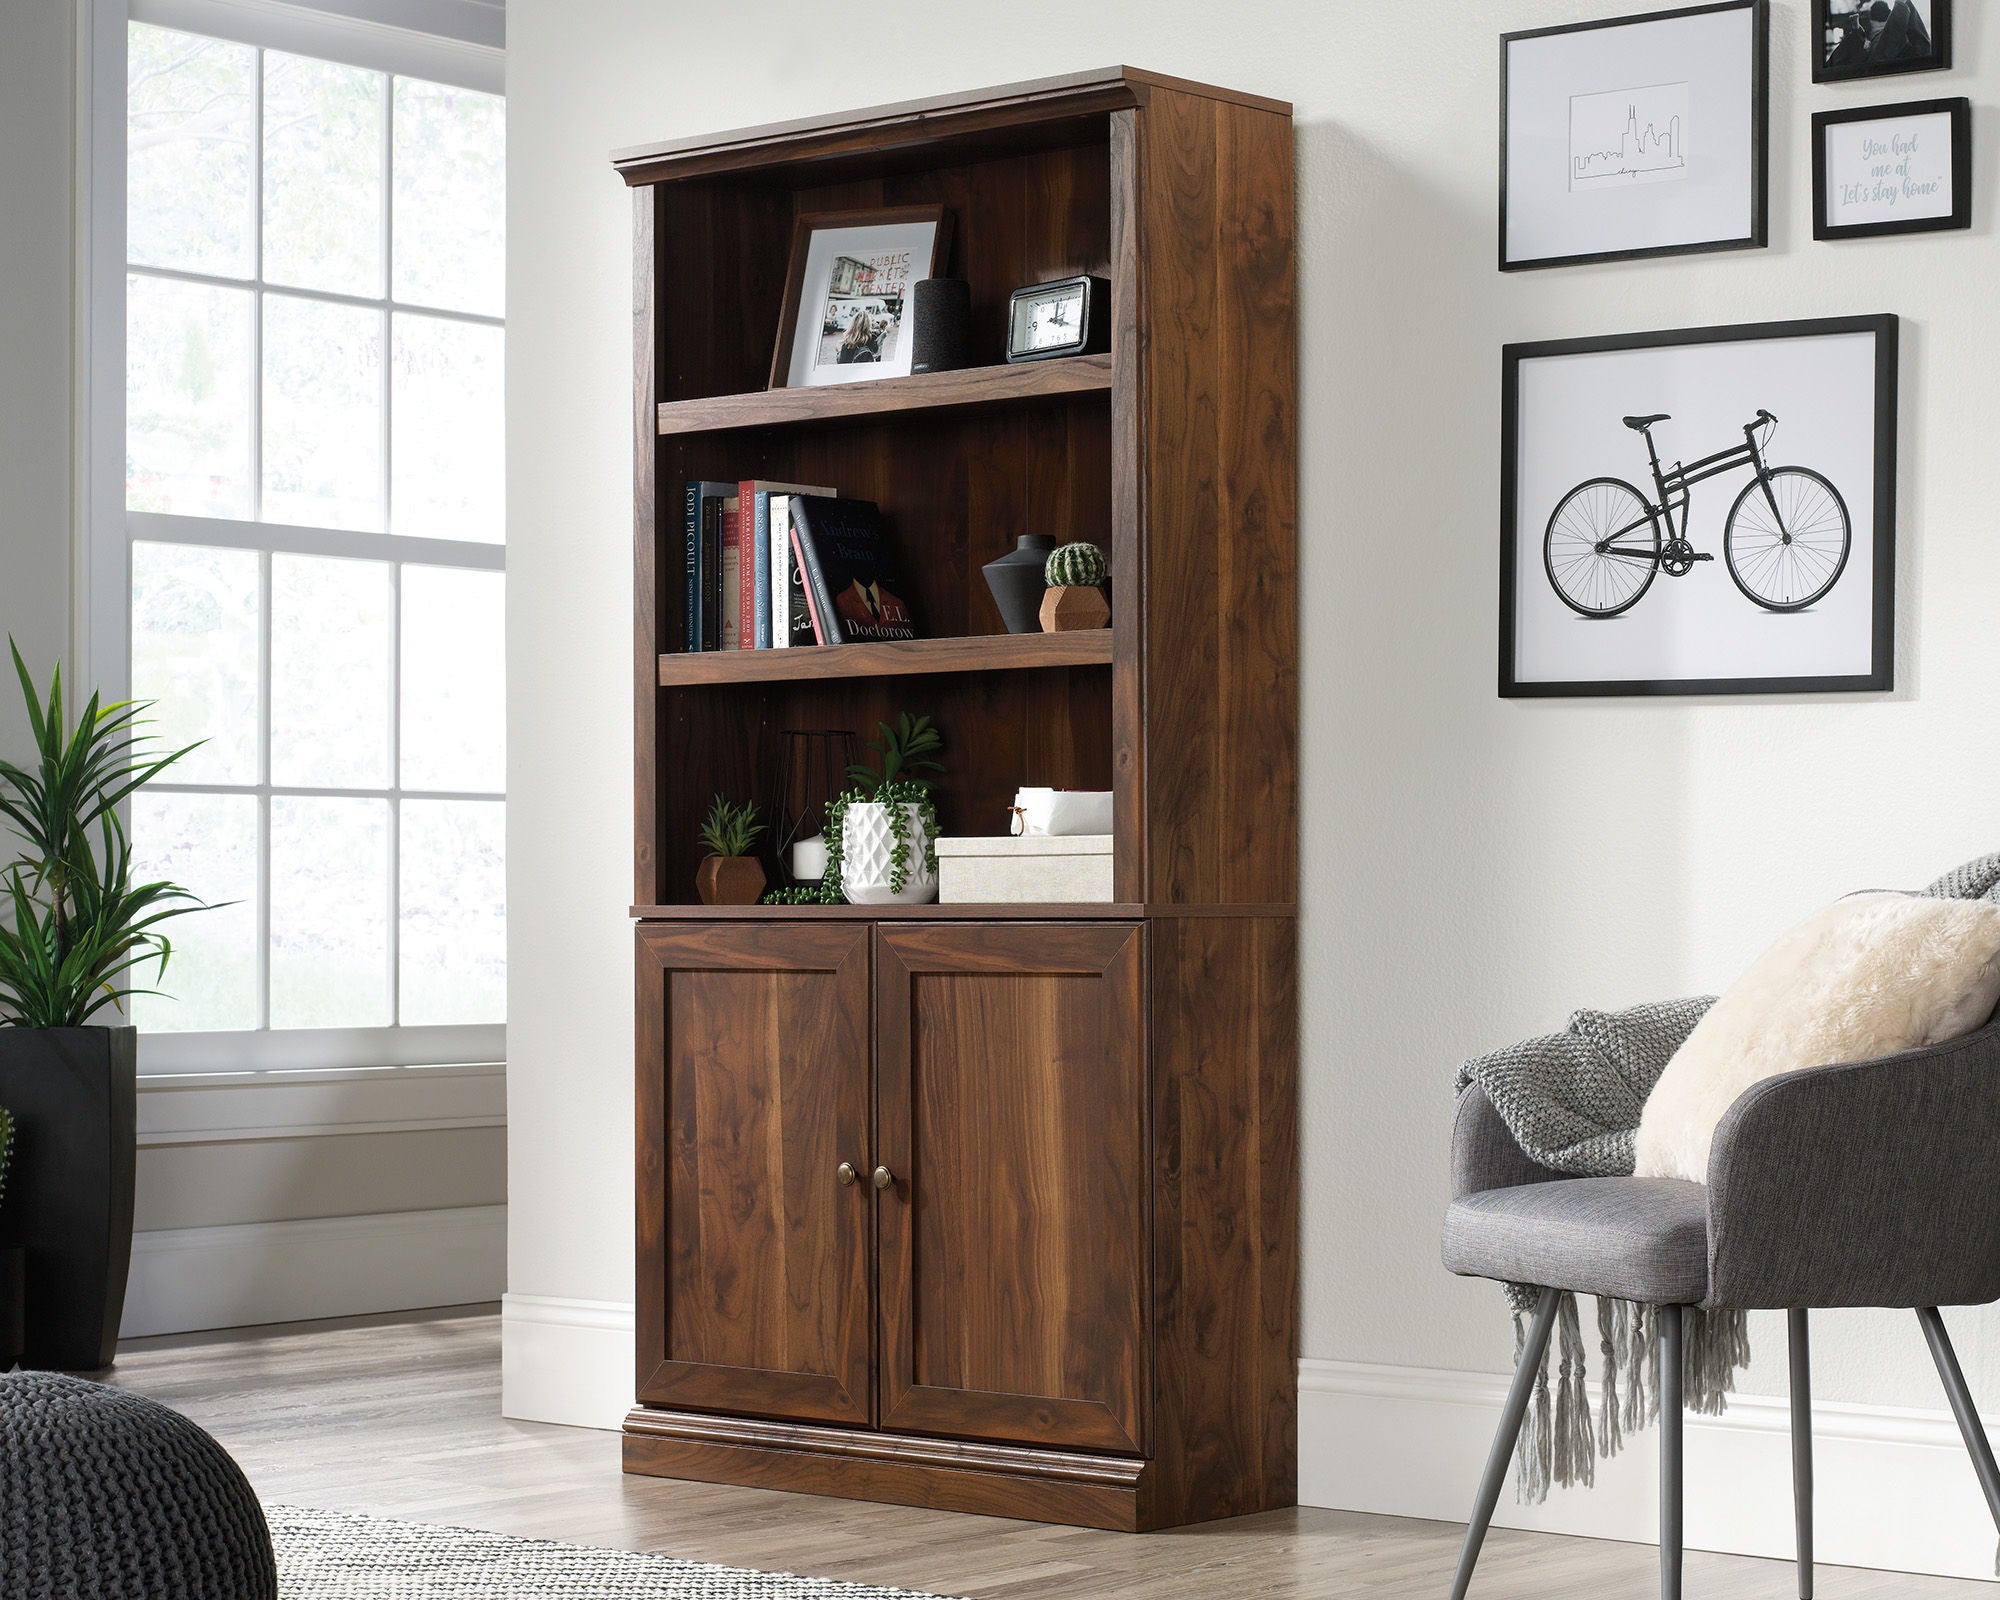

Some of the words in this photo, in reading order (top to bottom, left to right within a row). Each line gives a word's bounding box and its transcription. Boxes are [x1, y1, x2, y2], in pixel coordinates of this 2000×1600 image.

[1862, 138, 1888, 161] You
[1892, 133, 1919, 156] had
[1871, 164, 1893, 177] me
[1895, 155, 1912, 177] at
[1872, 178, 1899, 207] stay
[870, 252, 910, 268] PUBLIC
[686, 486, 696, 516] JODI
[686, 521, 696, 576] PICOULT
[881, 604, 911, 623] E.L.
[846, 618, 914, 640] Doctorow
